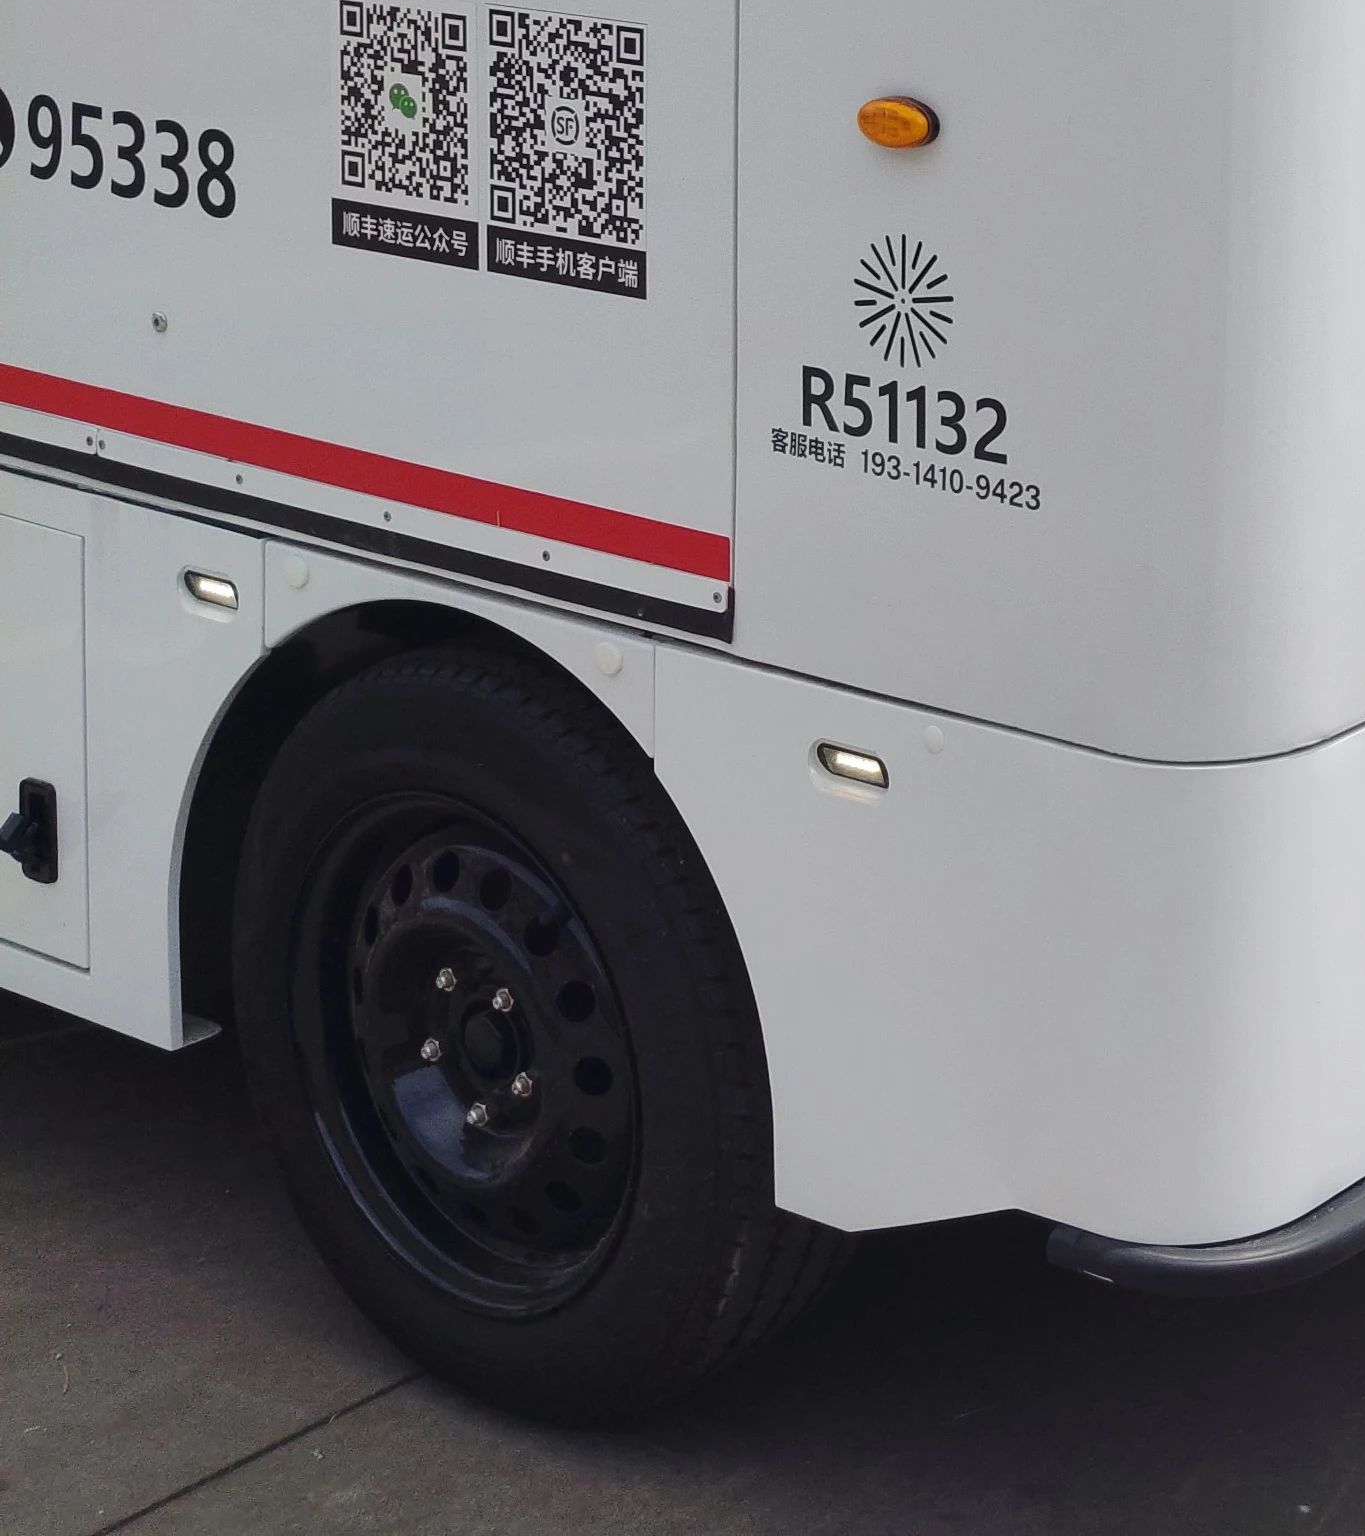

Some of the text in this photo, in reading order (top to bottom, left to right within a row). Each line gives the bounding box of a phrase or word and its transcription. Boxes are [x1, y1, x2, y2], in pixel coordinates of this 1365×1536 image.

[27, 94, 236, 219] 95338
[342, 211, 469, 257] 顺丰速运公众号
[495, 238, 639, 289] 顺丰手机客户端
[802, 365, 1008, 465] R51132
[771, 427, 1041, 511] 客服电话 193-1410-9423
